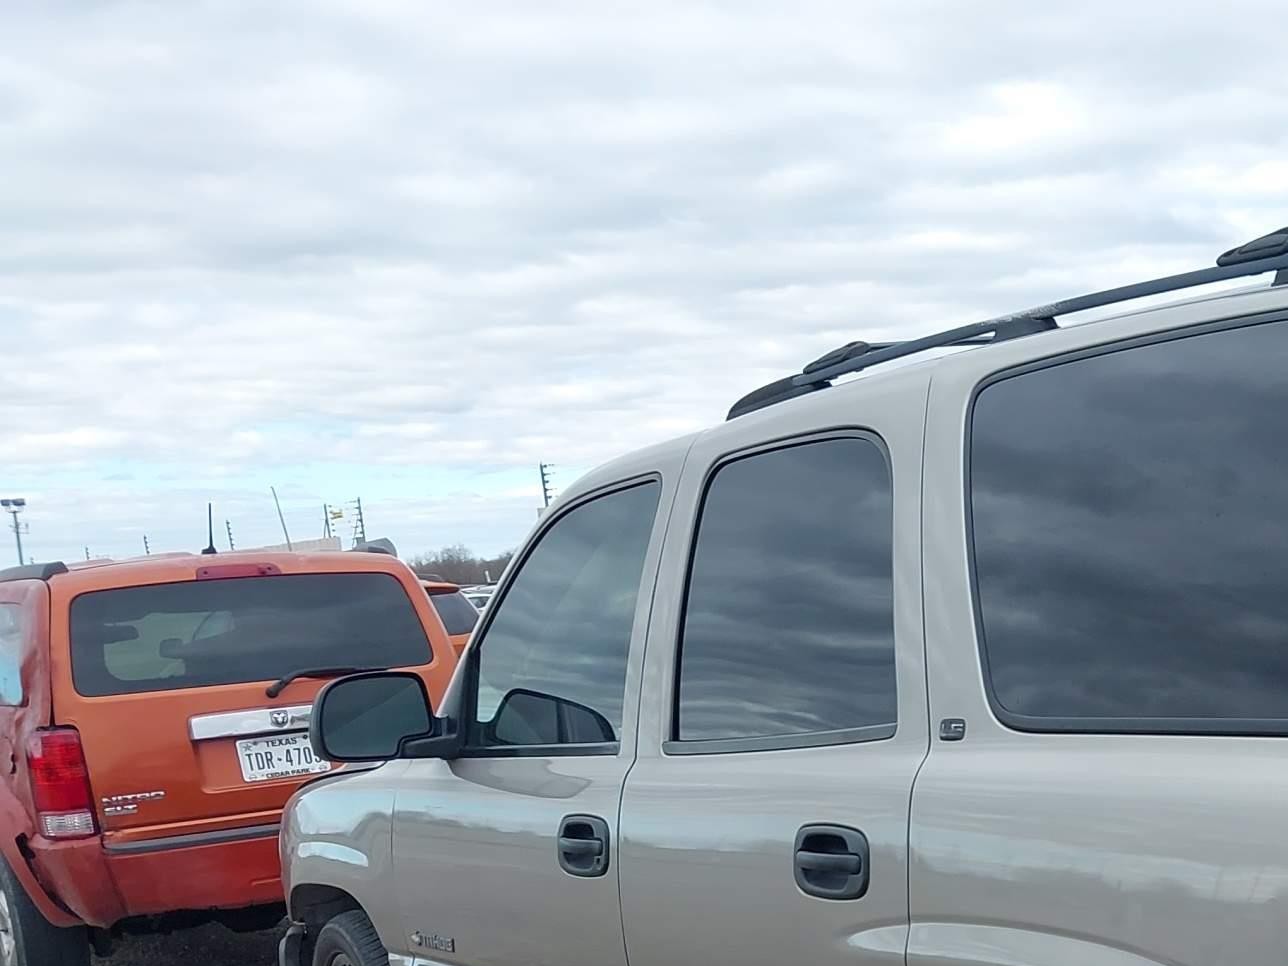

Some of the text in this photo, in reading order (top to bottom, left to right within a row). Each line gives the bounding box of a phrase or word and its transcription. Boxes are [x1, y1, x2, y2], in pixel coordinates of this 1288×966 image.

[265, 737, 297, 748] TEXAS
[265, 768, 311, 779] CEDAR PARK
[101, 790, 166, 807] NITRO
